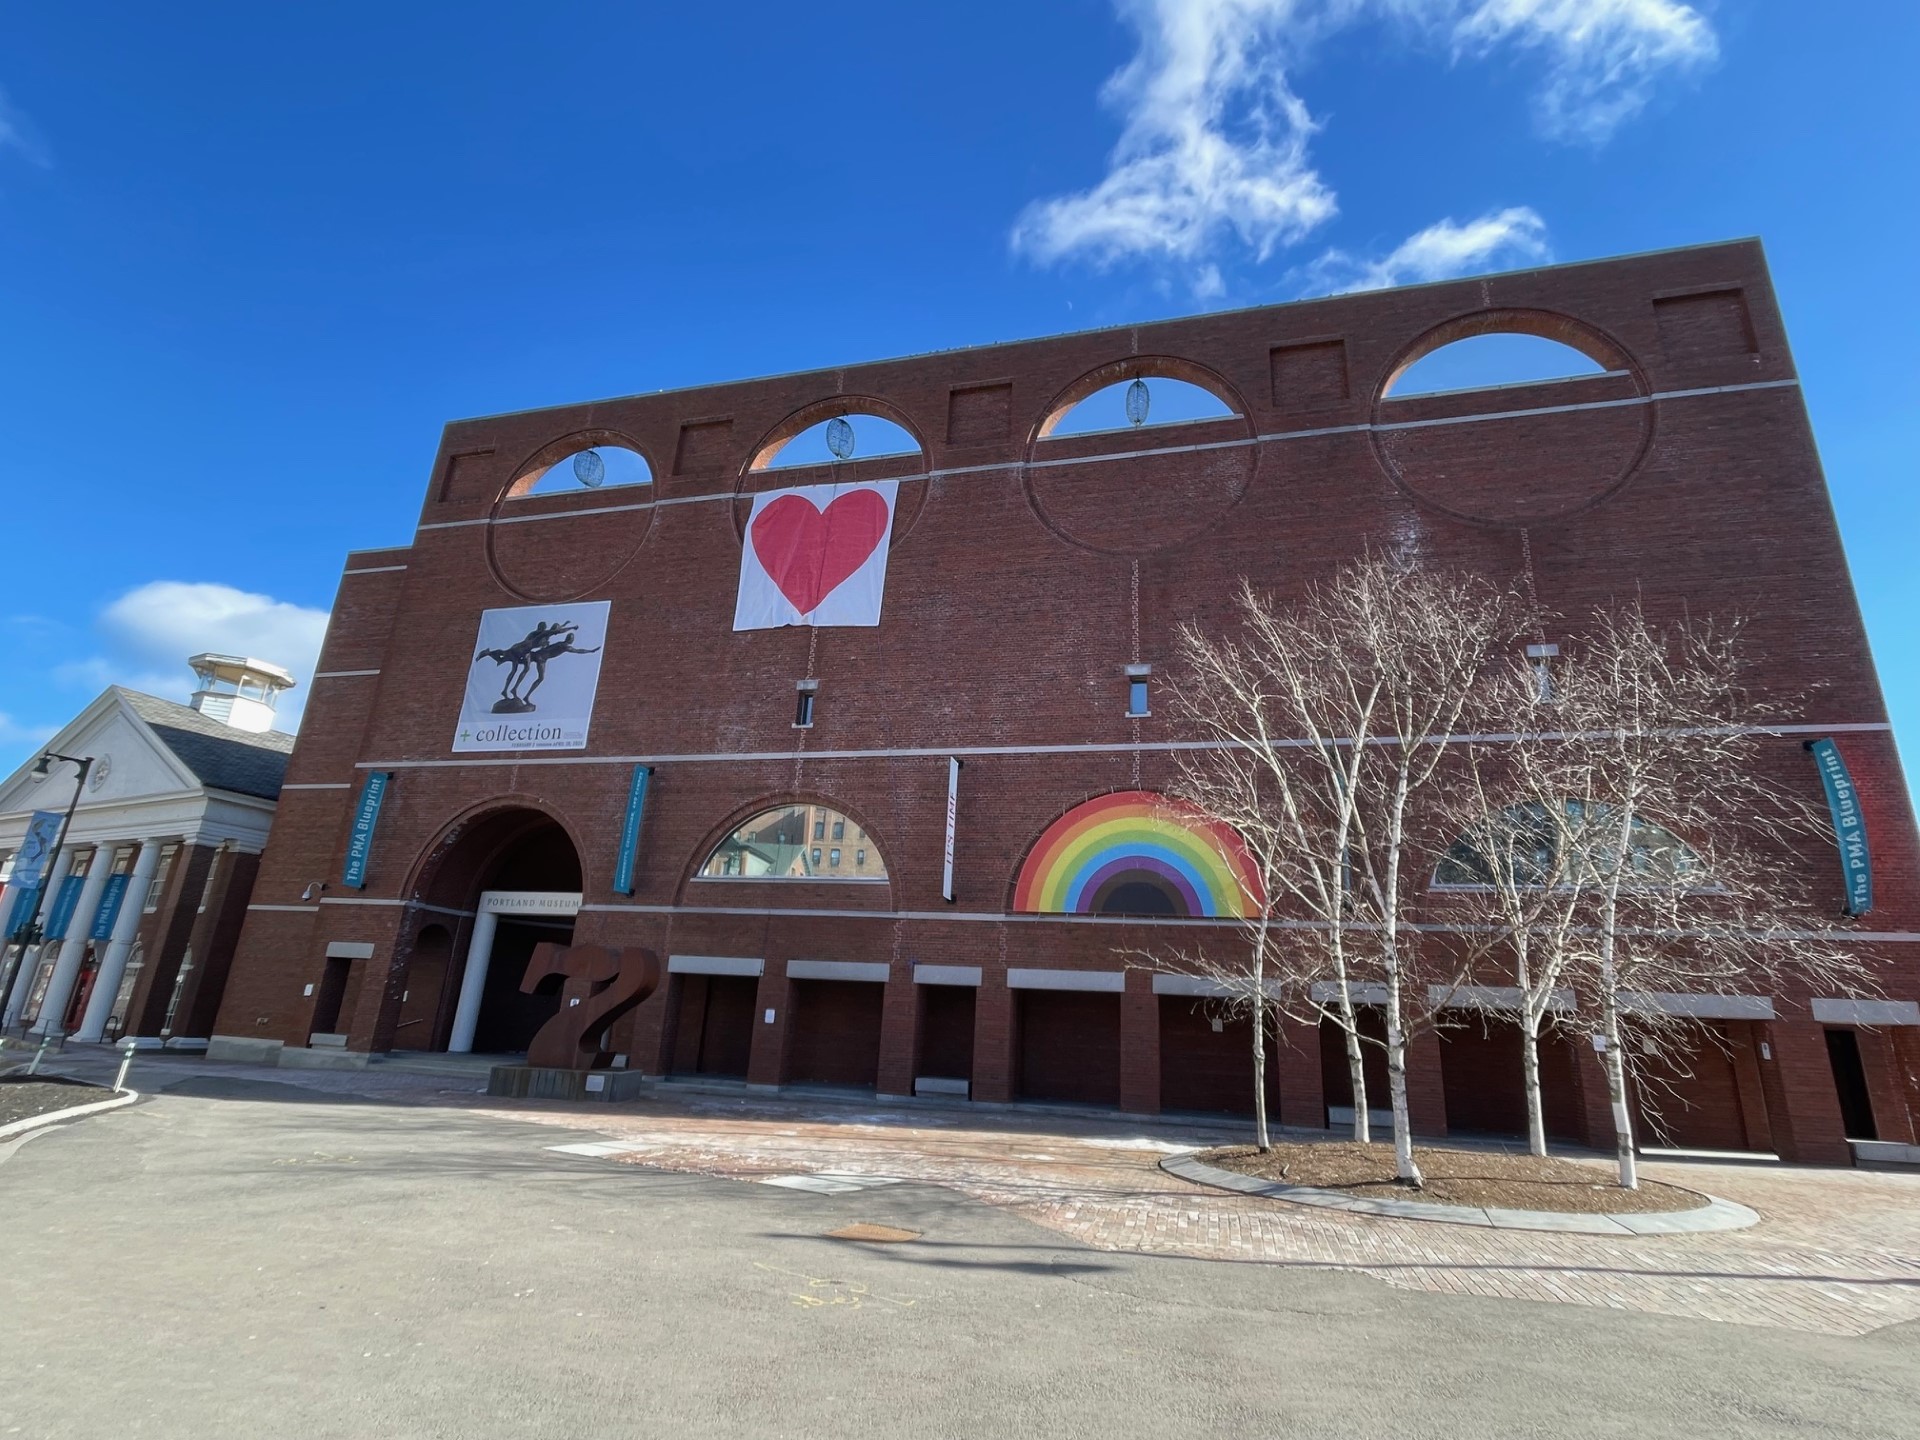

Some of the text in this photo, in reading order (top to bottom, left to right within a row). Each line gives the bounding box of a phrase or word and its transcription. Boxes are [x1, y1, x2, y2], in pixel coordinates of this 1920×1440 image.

[476, 724, 561, 741] collection
[347, 778, 382, 880] The PMA Blueprint
[1821, 748, 1867, 905] The PMA Blueprint
[487, 898, 579, 908] PORTLAND MUSEUM
